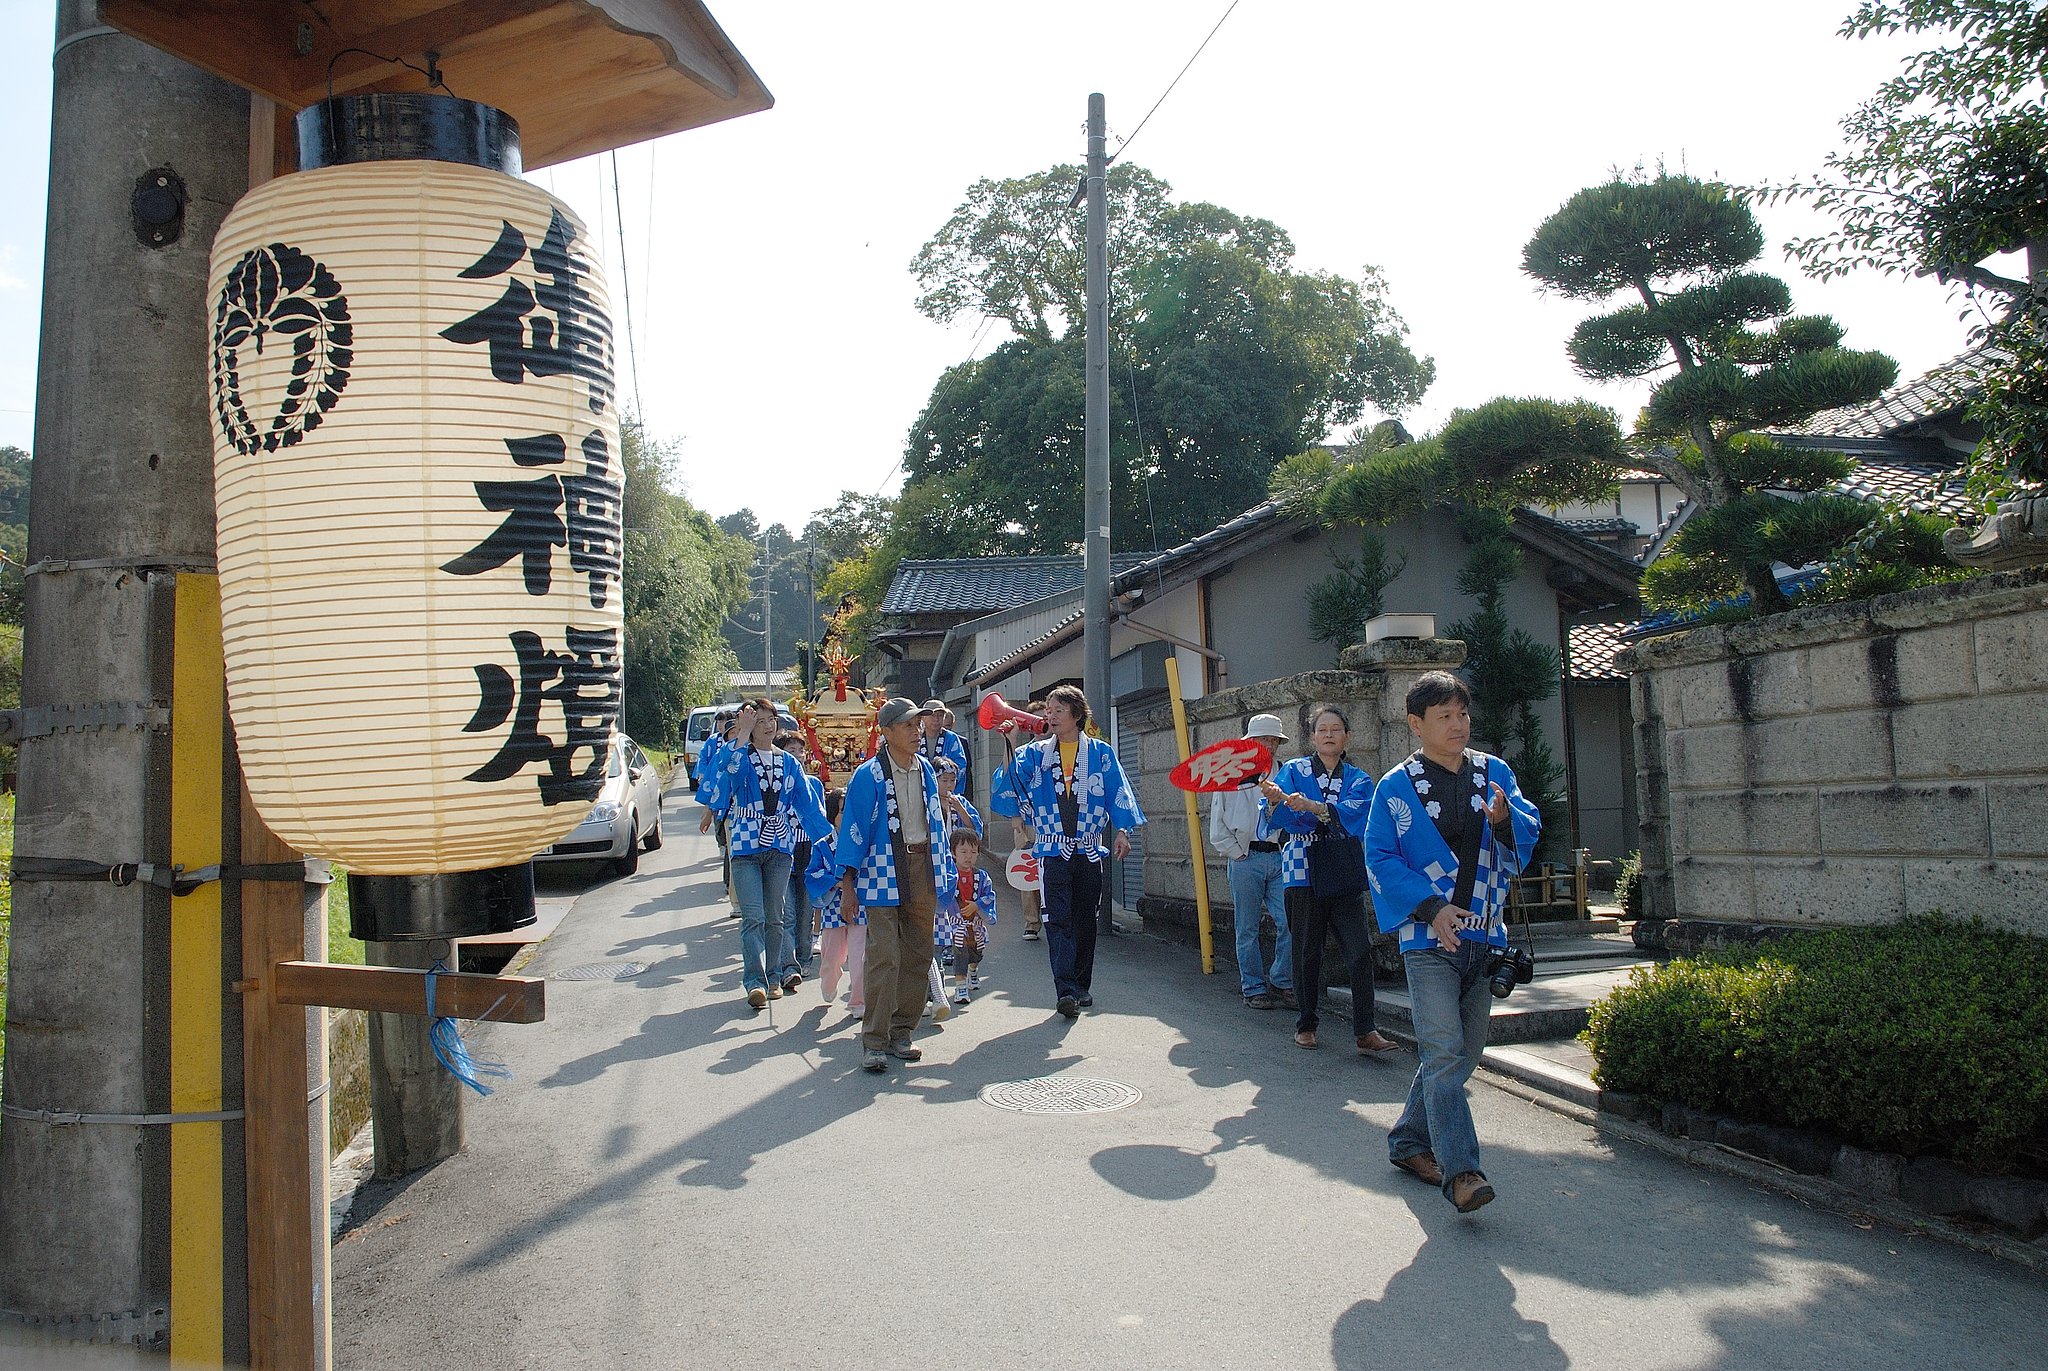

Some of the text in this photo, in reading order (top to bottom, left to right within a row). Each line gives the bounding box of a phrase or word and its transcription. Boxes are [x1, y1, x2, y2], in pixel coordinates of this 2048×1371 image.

[438, 206, 622, 807] 御神燈
[1188, 746, 1259, 788] 祭
